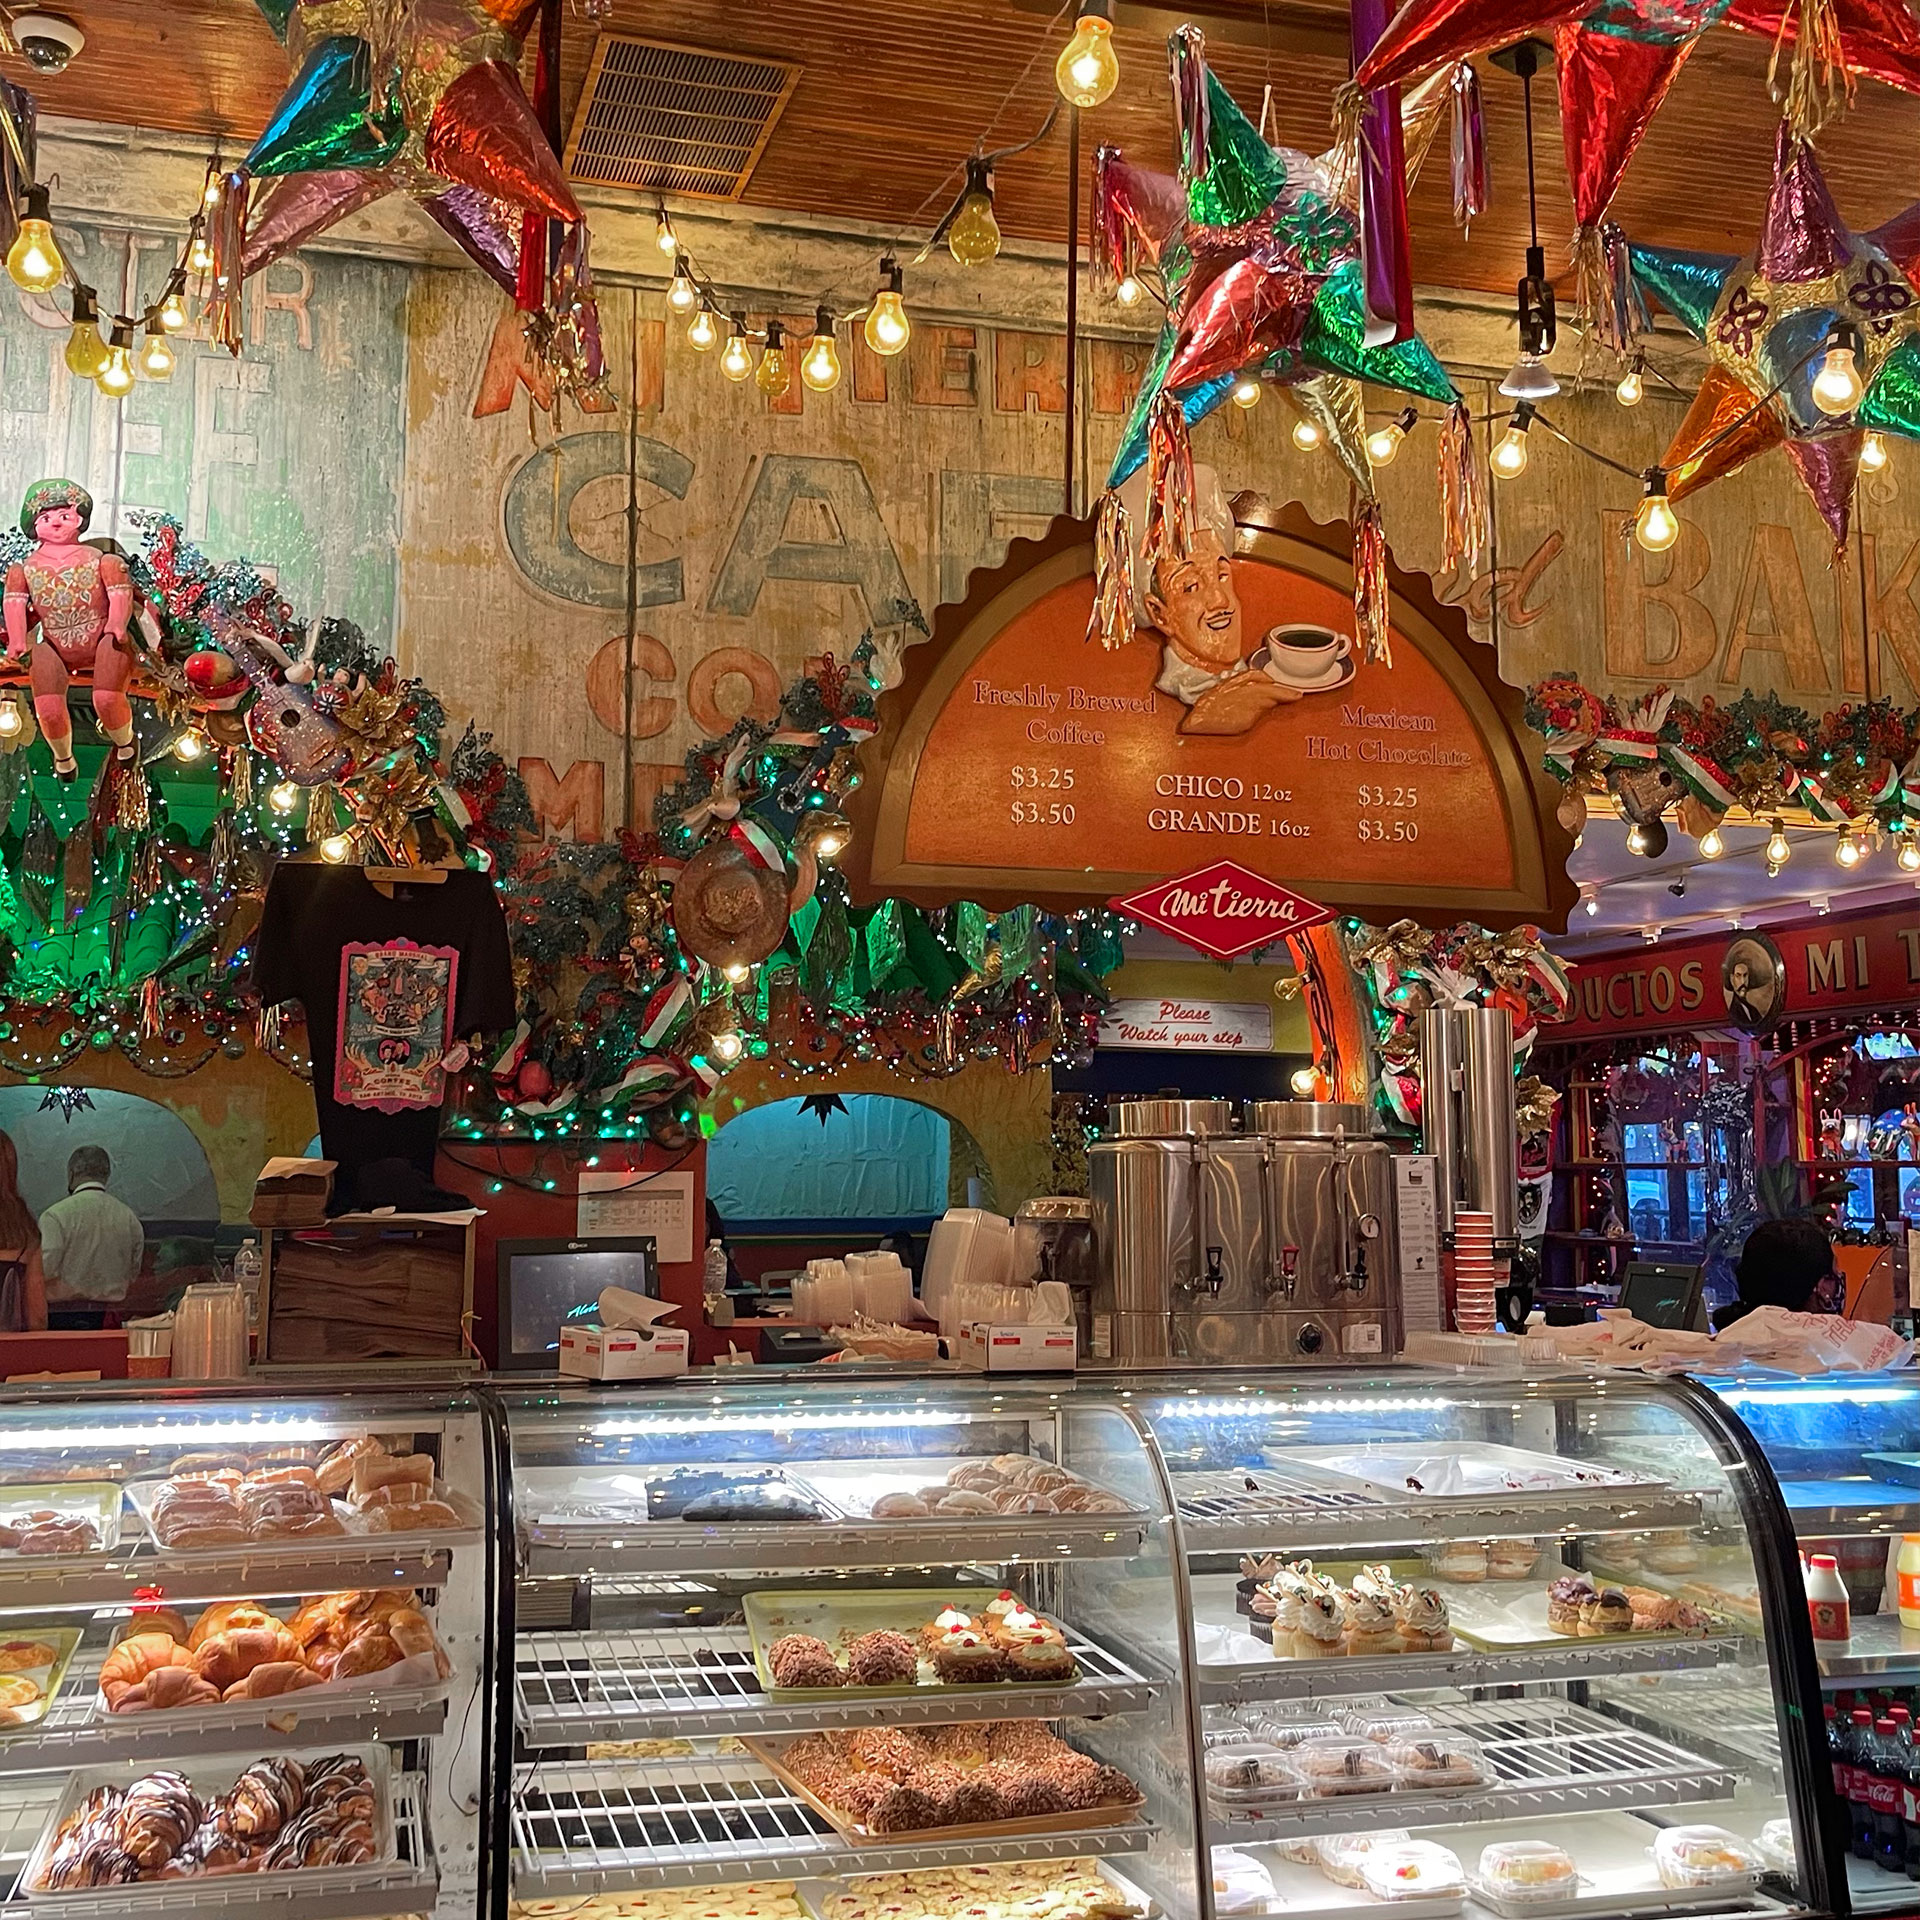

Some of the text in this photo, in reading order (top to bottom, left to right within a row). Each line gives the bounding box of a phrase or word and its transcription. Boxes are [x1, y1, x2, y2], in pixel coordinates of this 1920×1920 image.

[973, 680, 1157, 714] Freshly Brewed
[1340, 704, 1437, 732] Mexican
[1026, 719, 1105, 746] Coffee
[1305, 736, 1472, 768] Hot Chocolate
[1010, 765, 1075, 790] $3.25
[1155, 774, 1293, 802] CHICO 12oz
[1358, 784, 1418, 808] $3.25
[1010, 800, 1076, 826] $3.50
[1148, 808, 1311, 837] GRANDE 16oz
[1358, 818, 1419, 843] $3.50
[1806, 936, 1871, 994] MI
[1159, 1000, 1211, 1020] Please
[1118, 1023, 1169, 1042] Watch
[1174, 1032, 1209, 1047] your
[374, 1077, 412, 1086] CORTEZ
